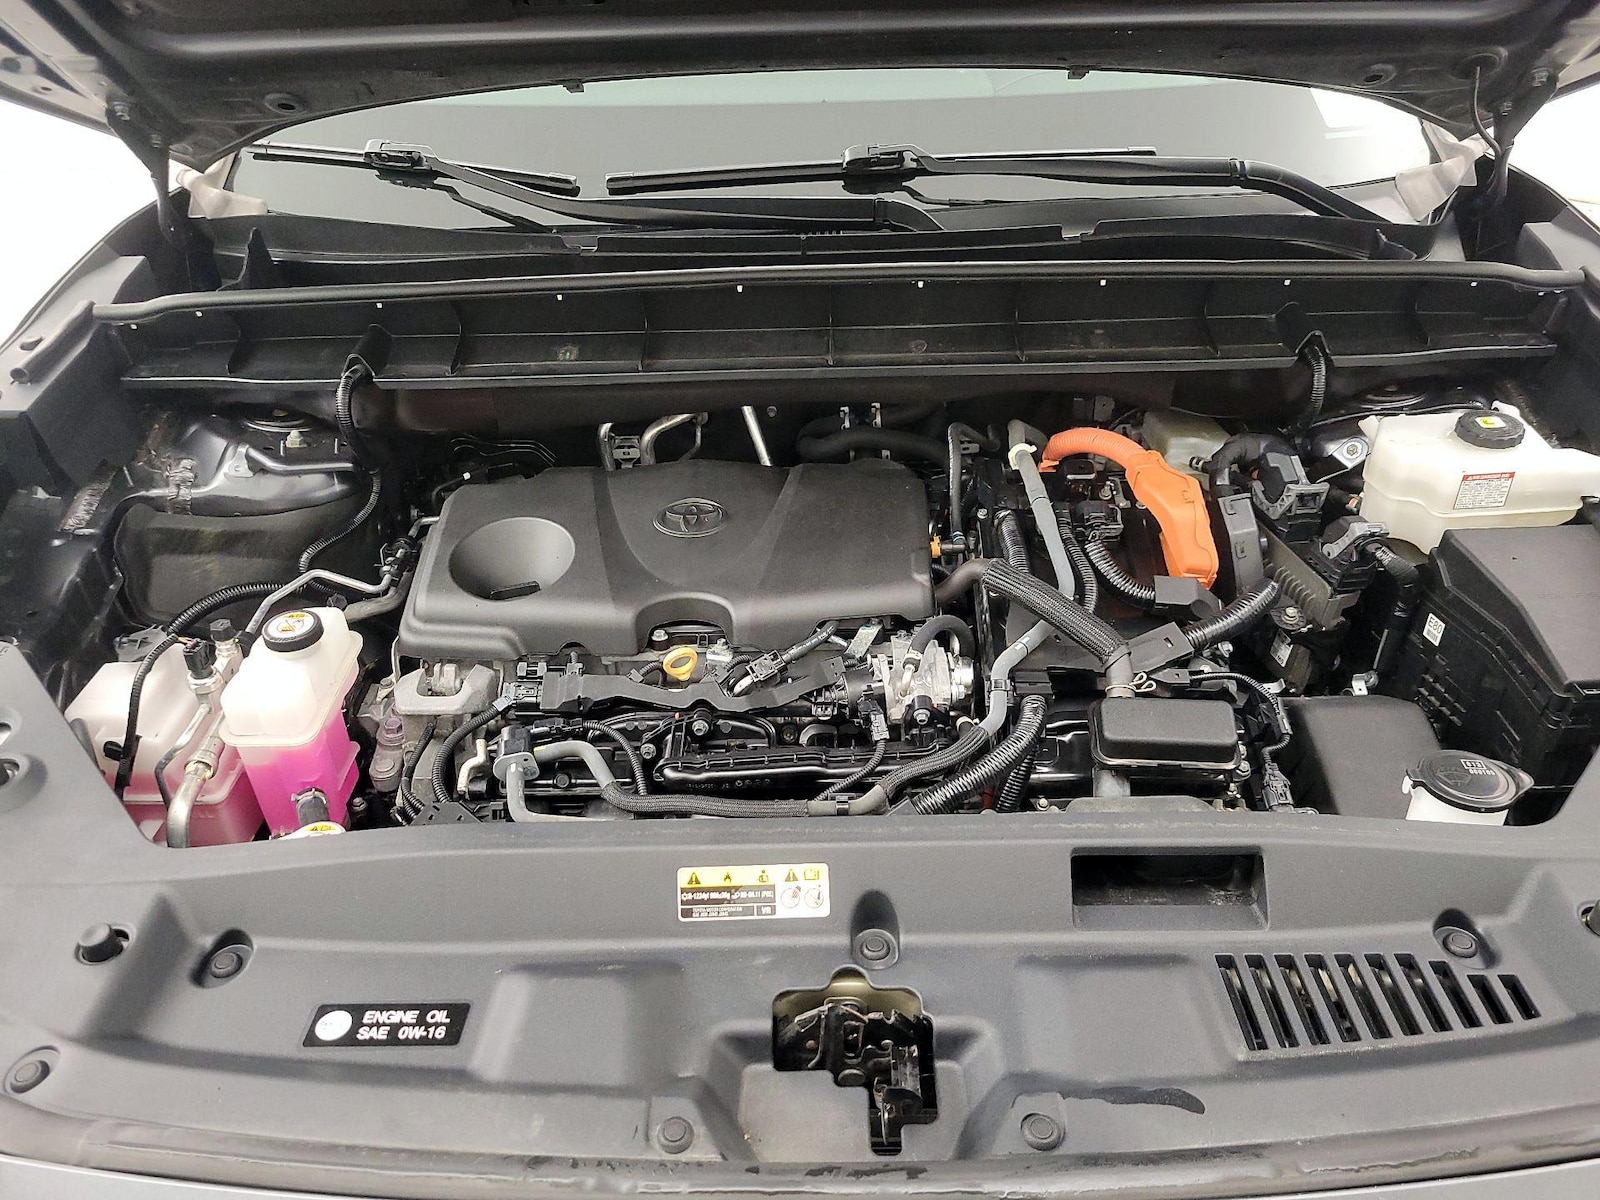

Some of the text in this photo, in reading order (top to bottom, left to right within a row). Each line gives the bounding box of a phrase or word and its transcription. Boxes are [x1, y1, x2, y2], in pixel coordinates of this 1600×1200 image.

[1428, 616, 1443, 634] E80
[362, 1010, 450, 1023] ENGINE OIL
[356, 1026, 390, 1040] SAE
[397, 1026, 446, 1040] 0W-16
